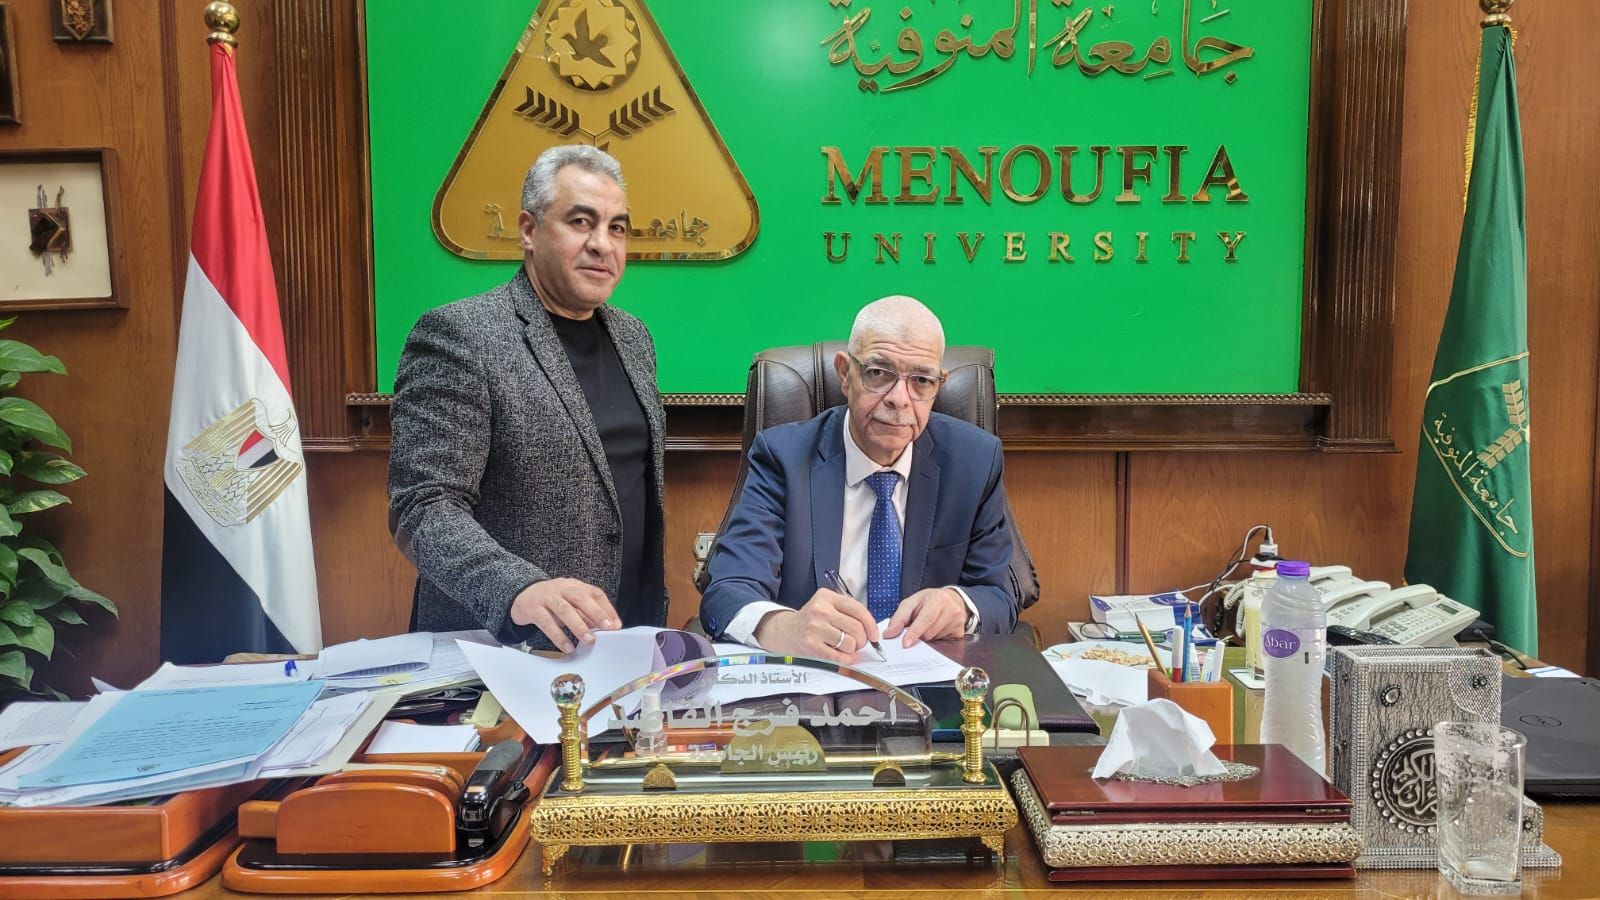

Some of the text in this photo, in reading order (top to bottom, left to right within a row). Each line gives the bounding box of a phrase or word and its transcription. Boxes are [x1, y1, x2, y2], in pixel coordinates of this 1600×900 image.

[820, 0, 1255, 94] جامعة المنوفية
[821, 143, 1249, 204] MENOUFIA
[823, 231, 1248, 264] UNIVERSITY
[1470, 468, 1518, 537] جامعة
[733, 697, 800, 738] فرج
[810, 688, 897, 728] أحمد
